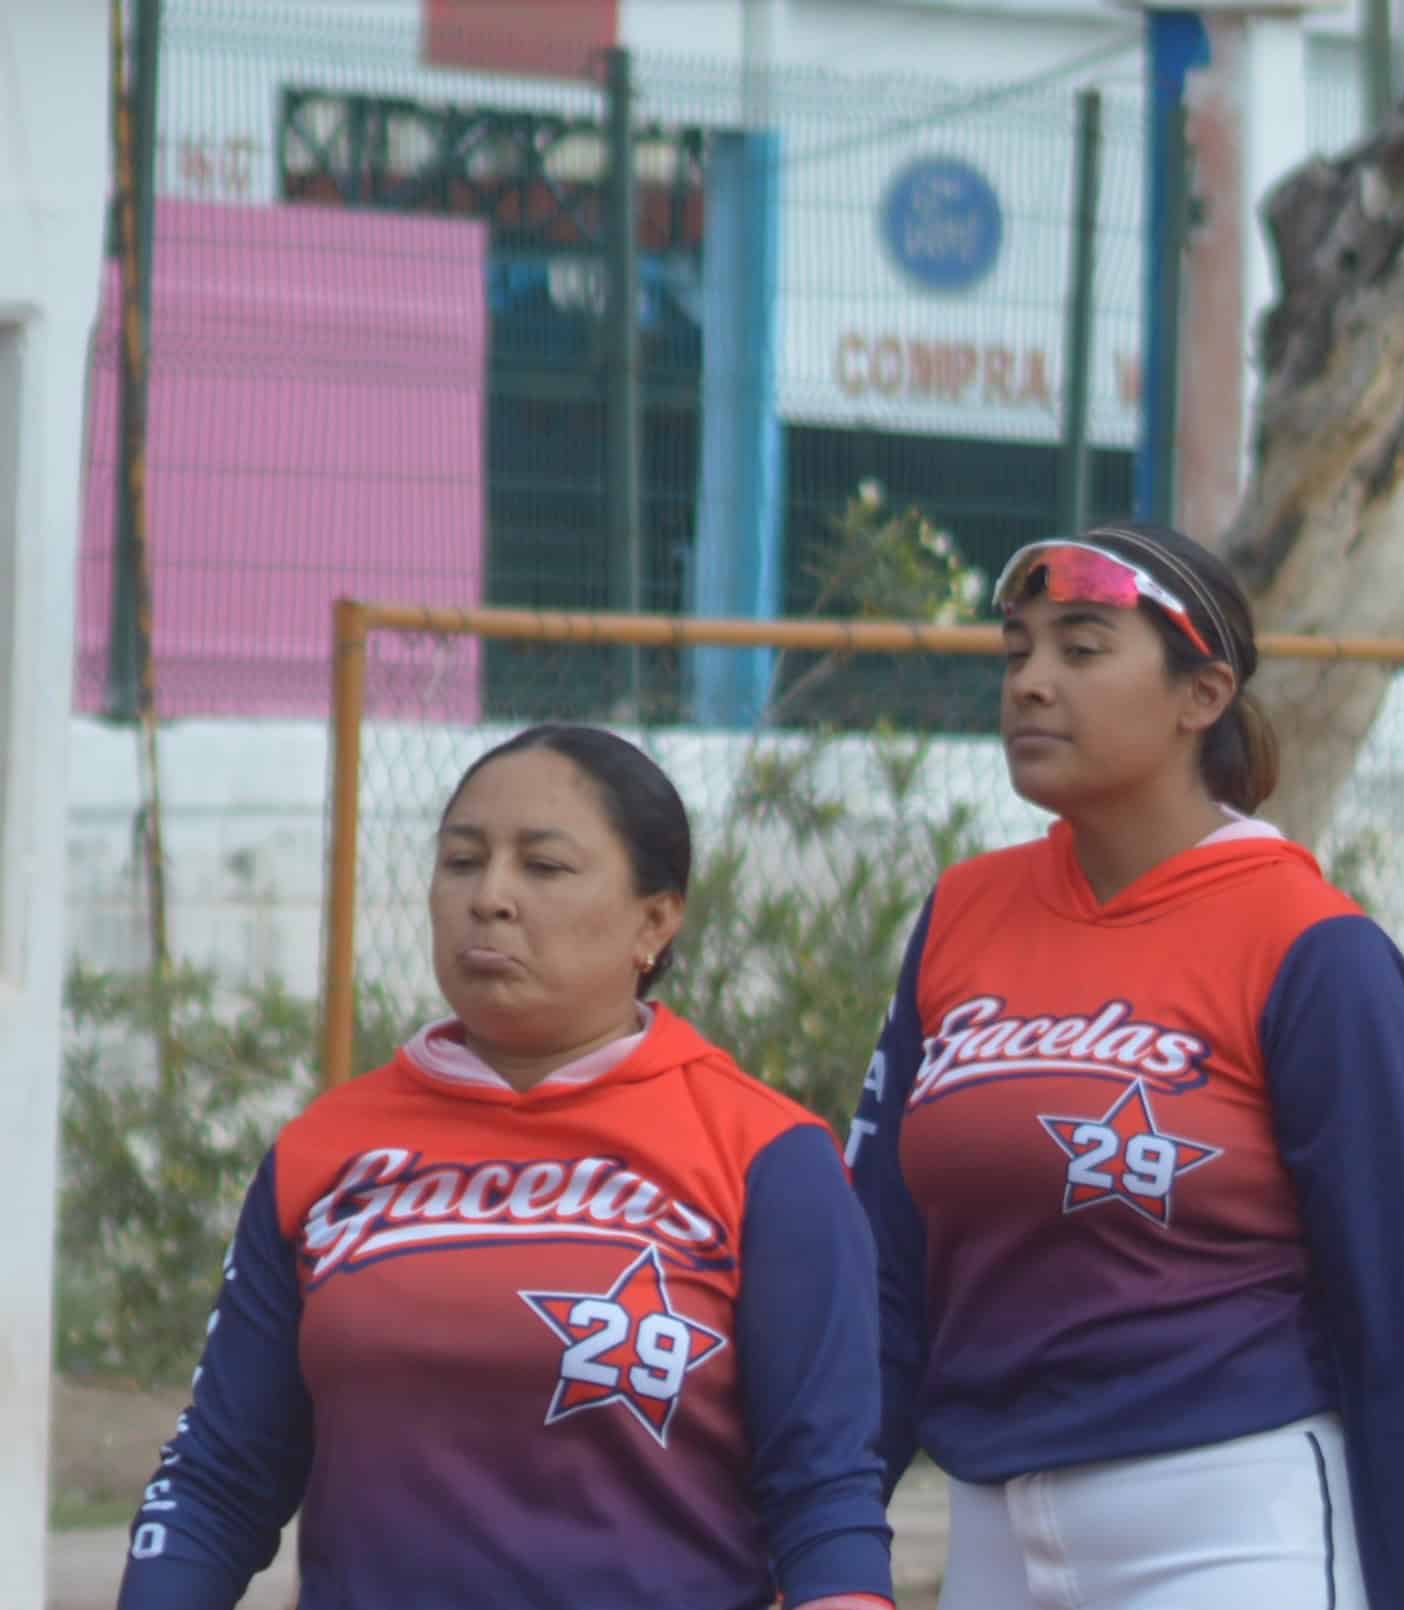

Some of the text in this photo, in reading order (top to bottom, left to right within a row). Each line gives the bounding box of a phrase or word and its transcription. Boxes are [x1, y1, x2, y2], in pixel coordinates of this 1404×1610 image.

[907, 995, 1204, 1106] Gacelas
[303, 1147, 722, 1277] Gacelas
[1066, 1124, 1177, 1198] 29
[560, 1299, 691, 1400] 29
